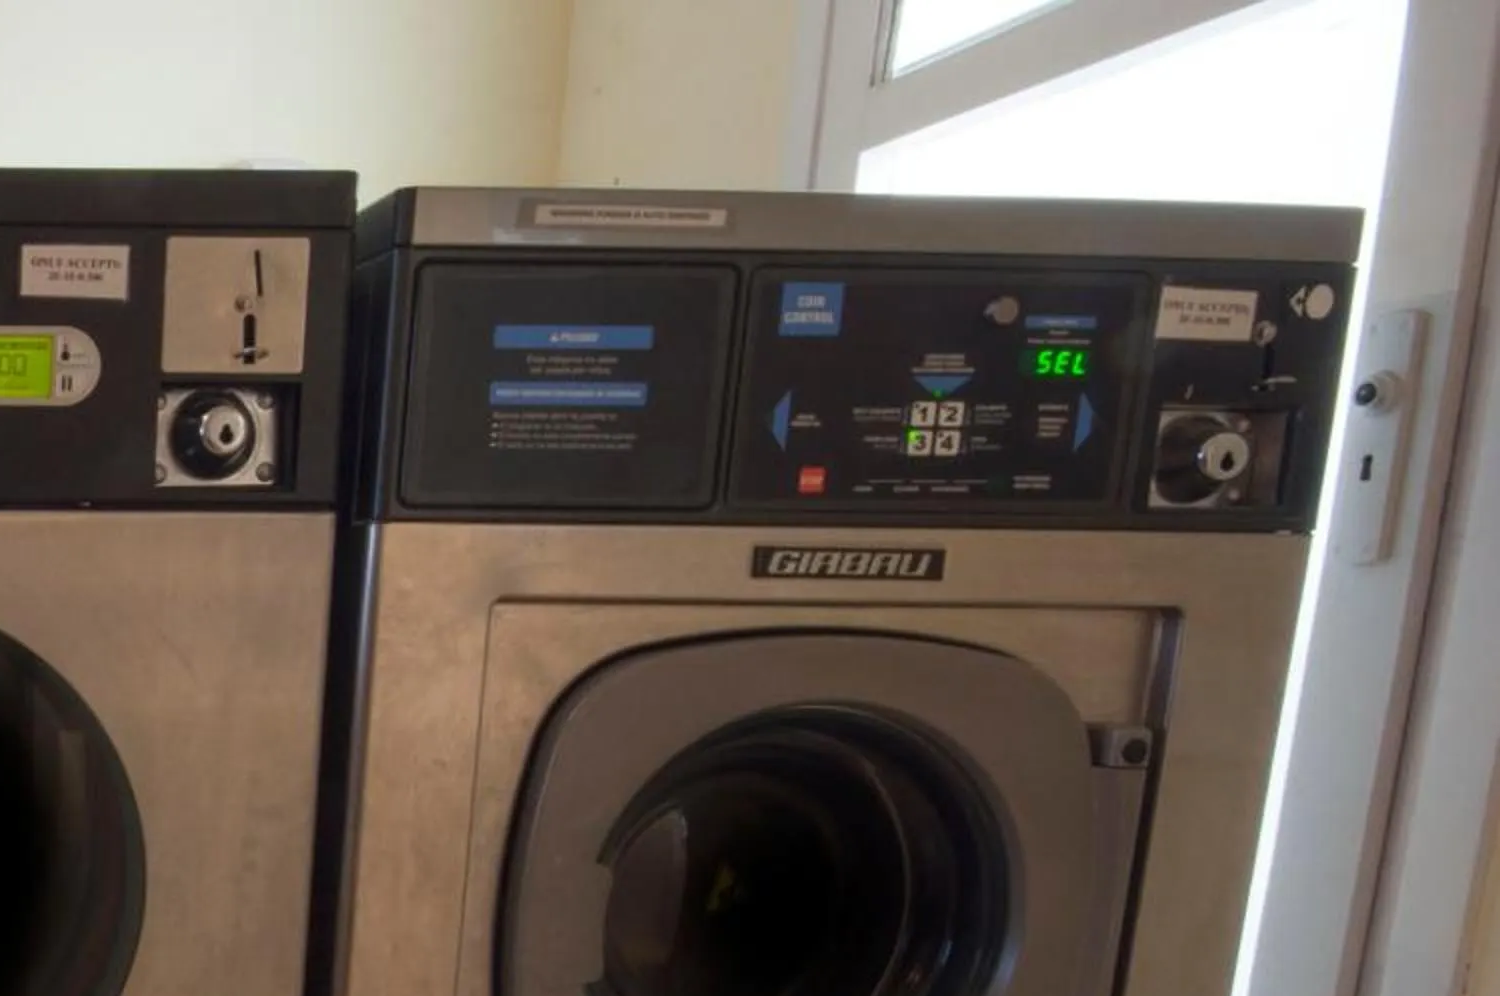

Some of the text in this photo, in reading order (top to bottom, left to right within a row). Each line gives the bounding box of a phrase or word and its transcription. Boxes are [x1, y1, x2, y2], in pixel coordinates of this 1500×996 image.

[1036, 350, 1086, 375] SEL
[945, 406, 957, 422] 2
[940, 435, 954, 450] 4
[768, 551, 932, 576] GIRBAU
